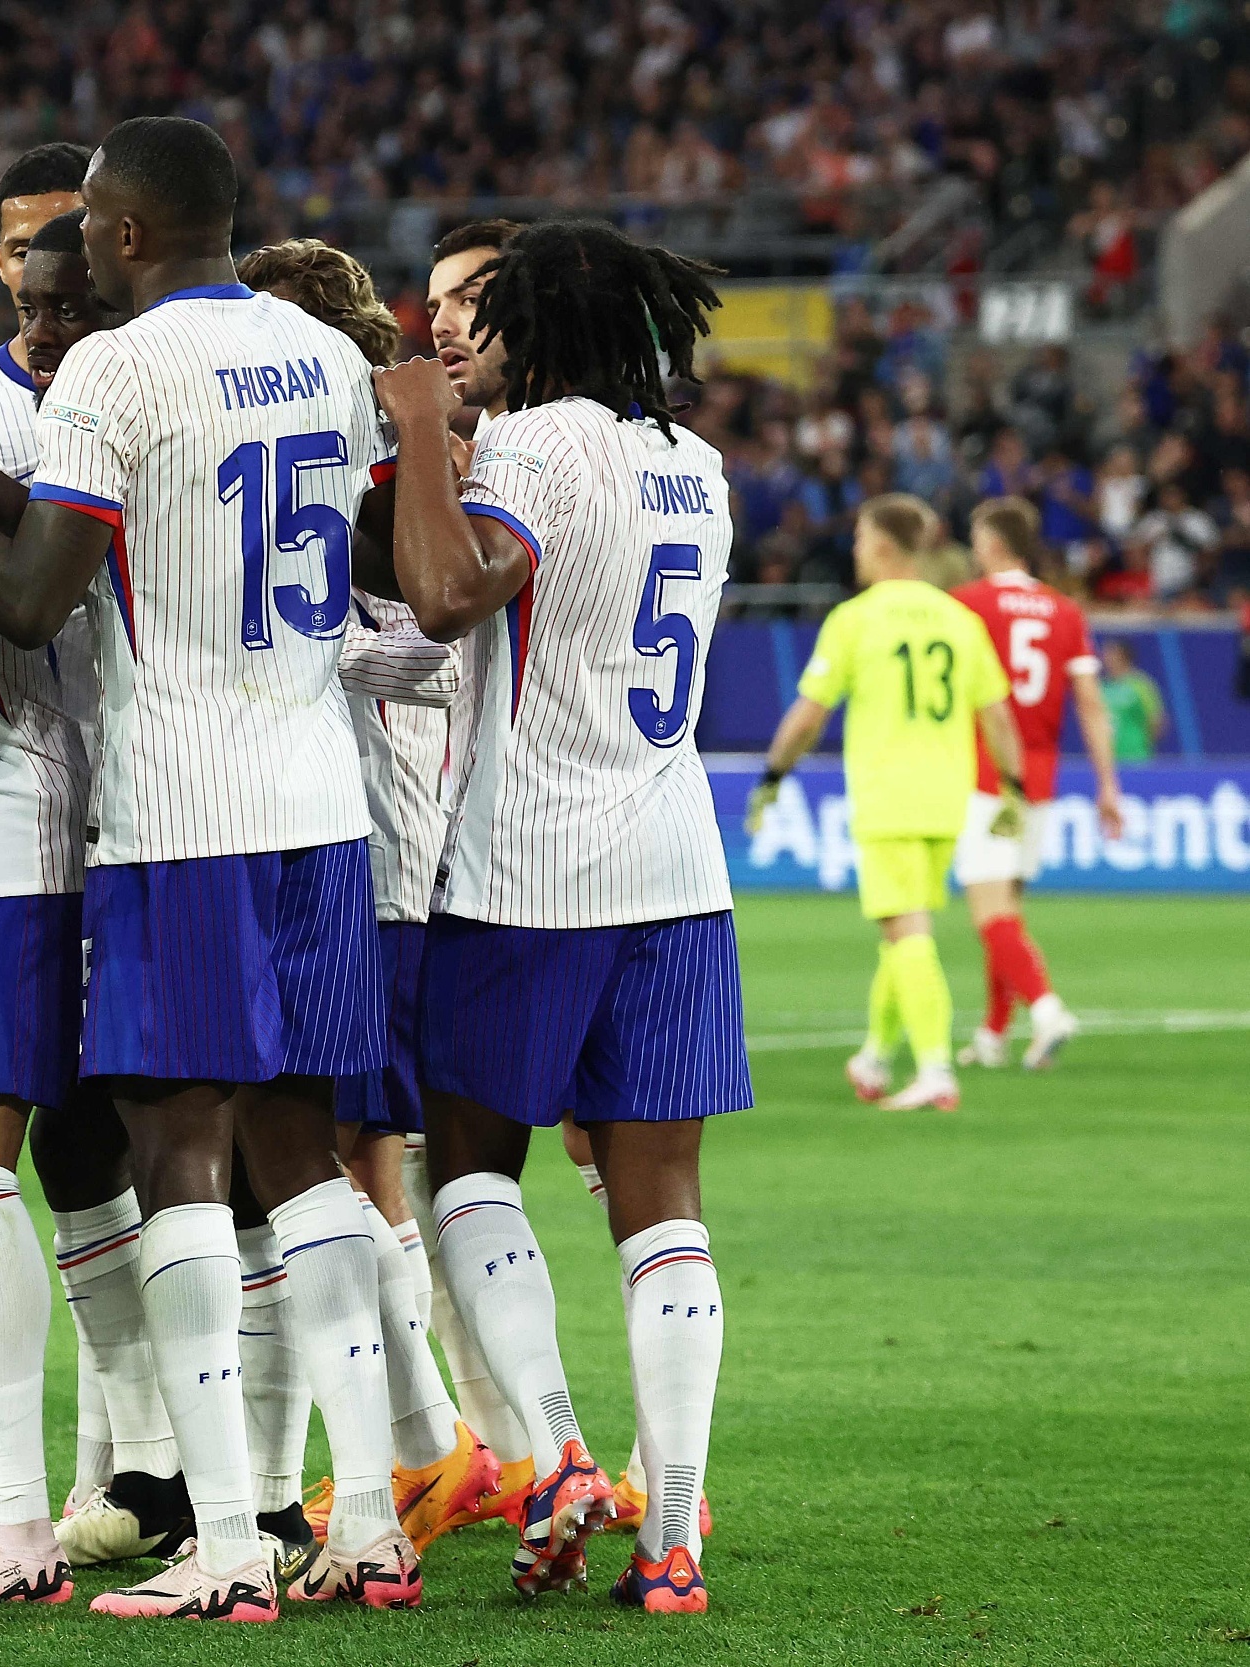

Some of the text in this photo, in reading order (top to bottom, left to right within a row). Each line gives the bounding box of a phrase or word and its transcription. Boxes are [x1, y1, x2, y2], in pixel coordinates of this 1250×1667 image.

[215, 356, 329, 411] THURAM
[217, 430, 353, 651] 15
[627, 542, 702, 749] 5
[891, 640, 955, 723] 13
[1009, 617, 1052, 707] 5
